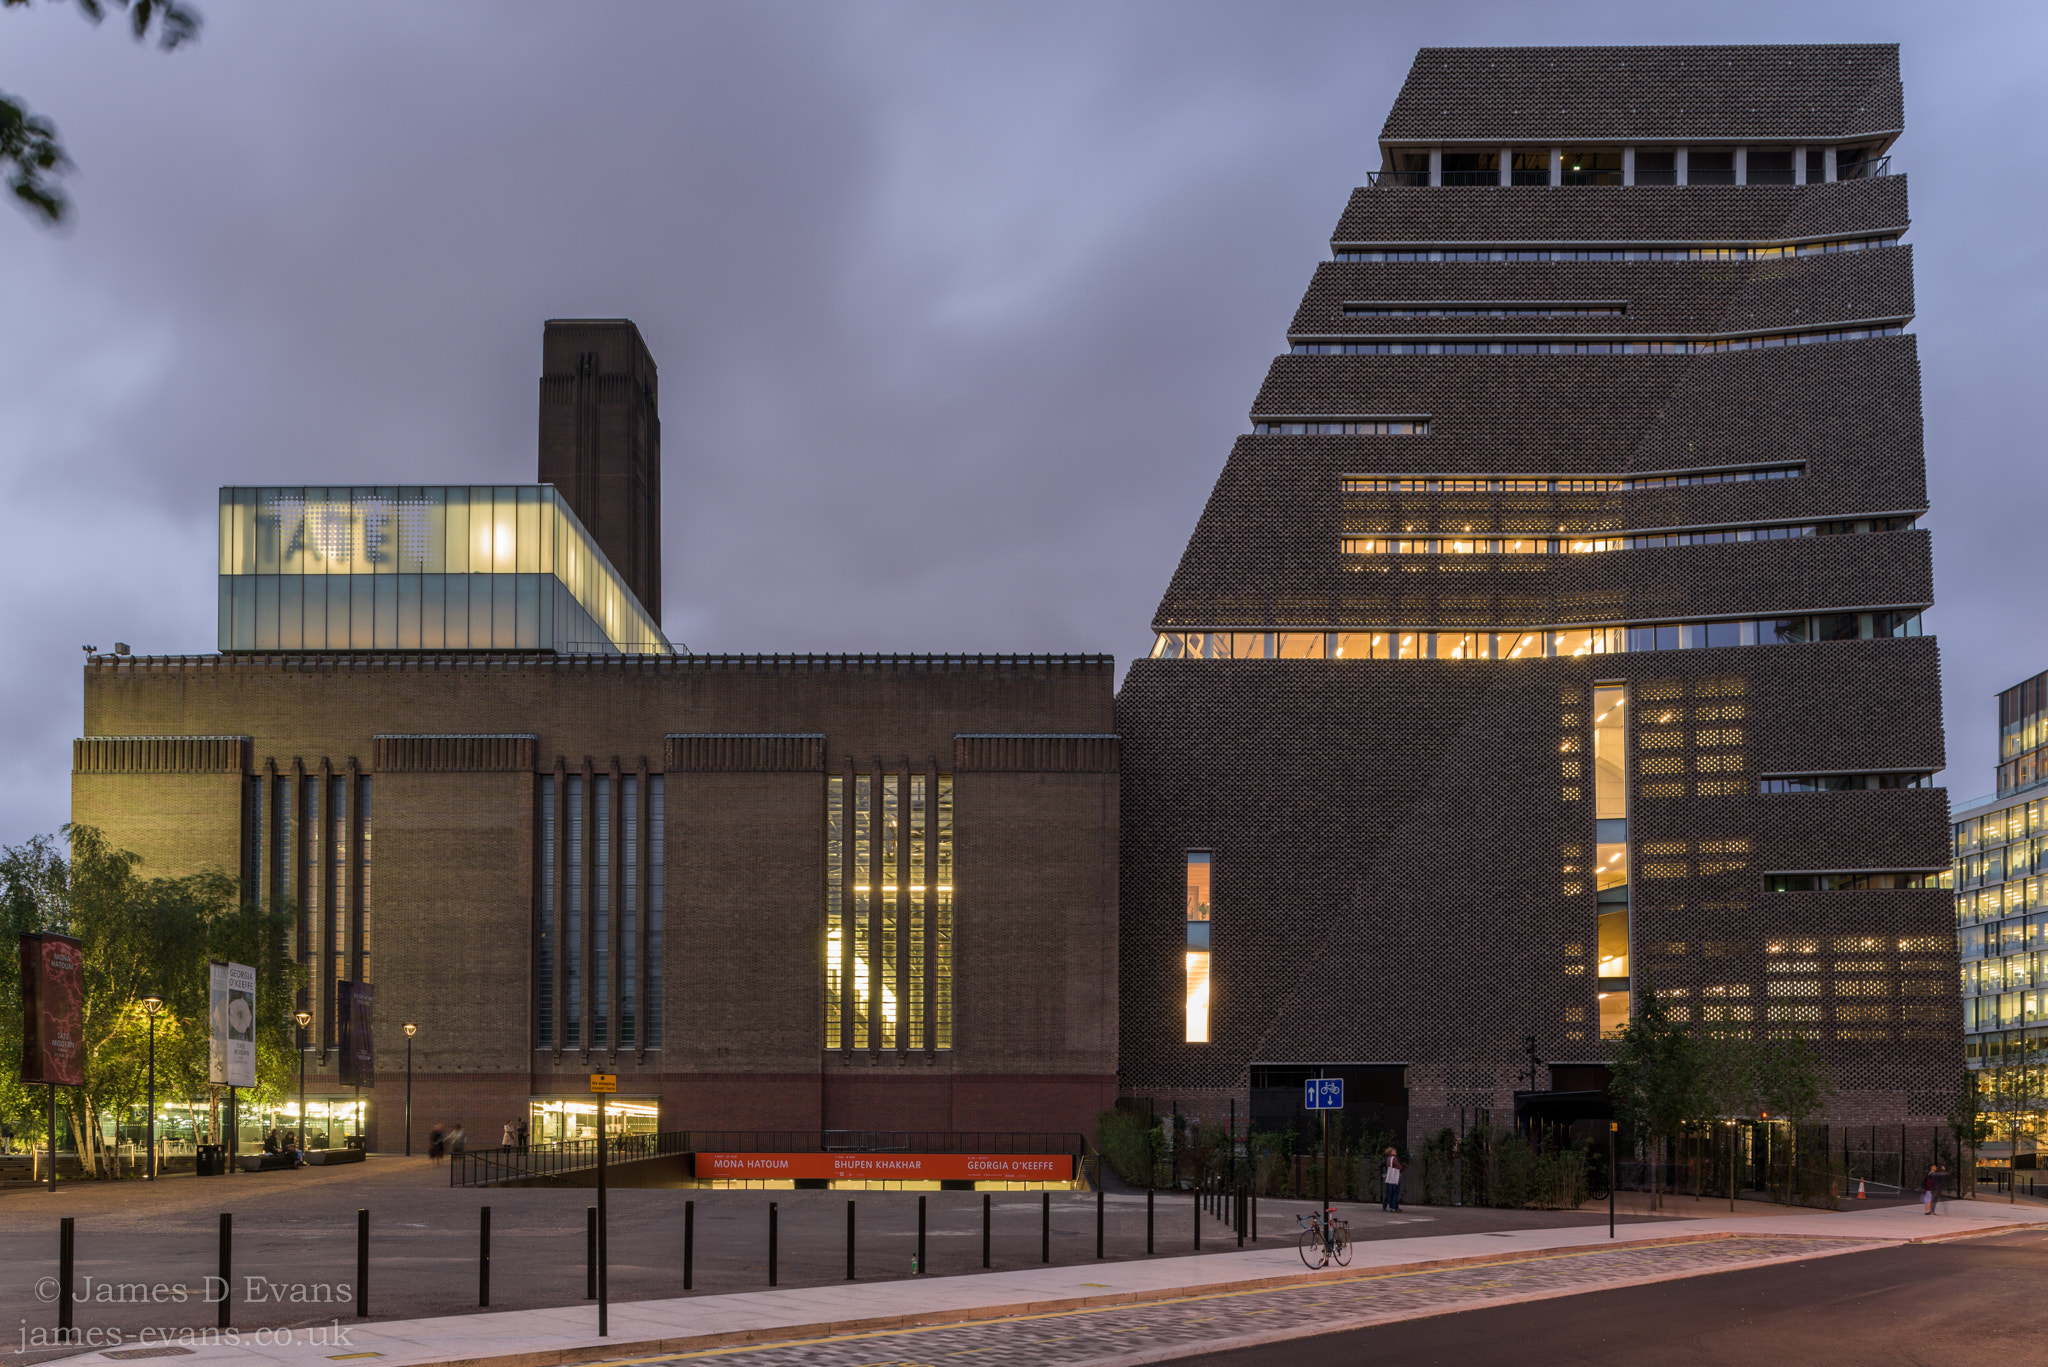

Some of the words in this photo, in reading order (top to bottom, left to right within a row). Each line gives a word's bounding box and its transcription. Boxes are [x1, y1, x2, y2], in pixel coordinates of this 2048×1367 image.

[230, 968, 253, 980] GEORGIA
[229, 978, 254, 991] O'KEEFFE
[714, 1159, 745, 1168] MONA
[747, 1159, 789, 1169] HATOUM
[834, 1160, 873, 1169] BHUPEN
[875, 1160, 922, 1169] KHAKHAR
[967, 1161, 1009, 1170] GEORGIA
[1012, 1161, 1054, 1170] O'KEEFFE
